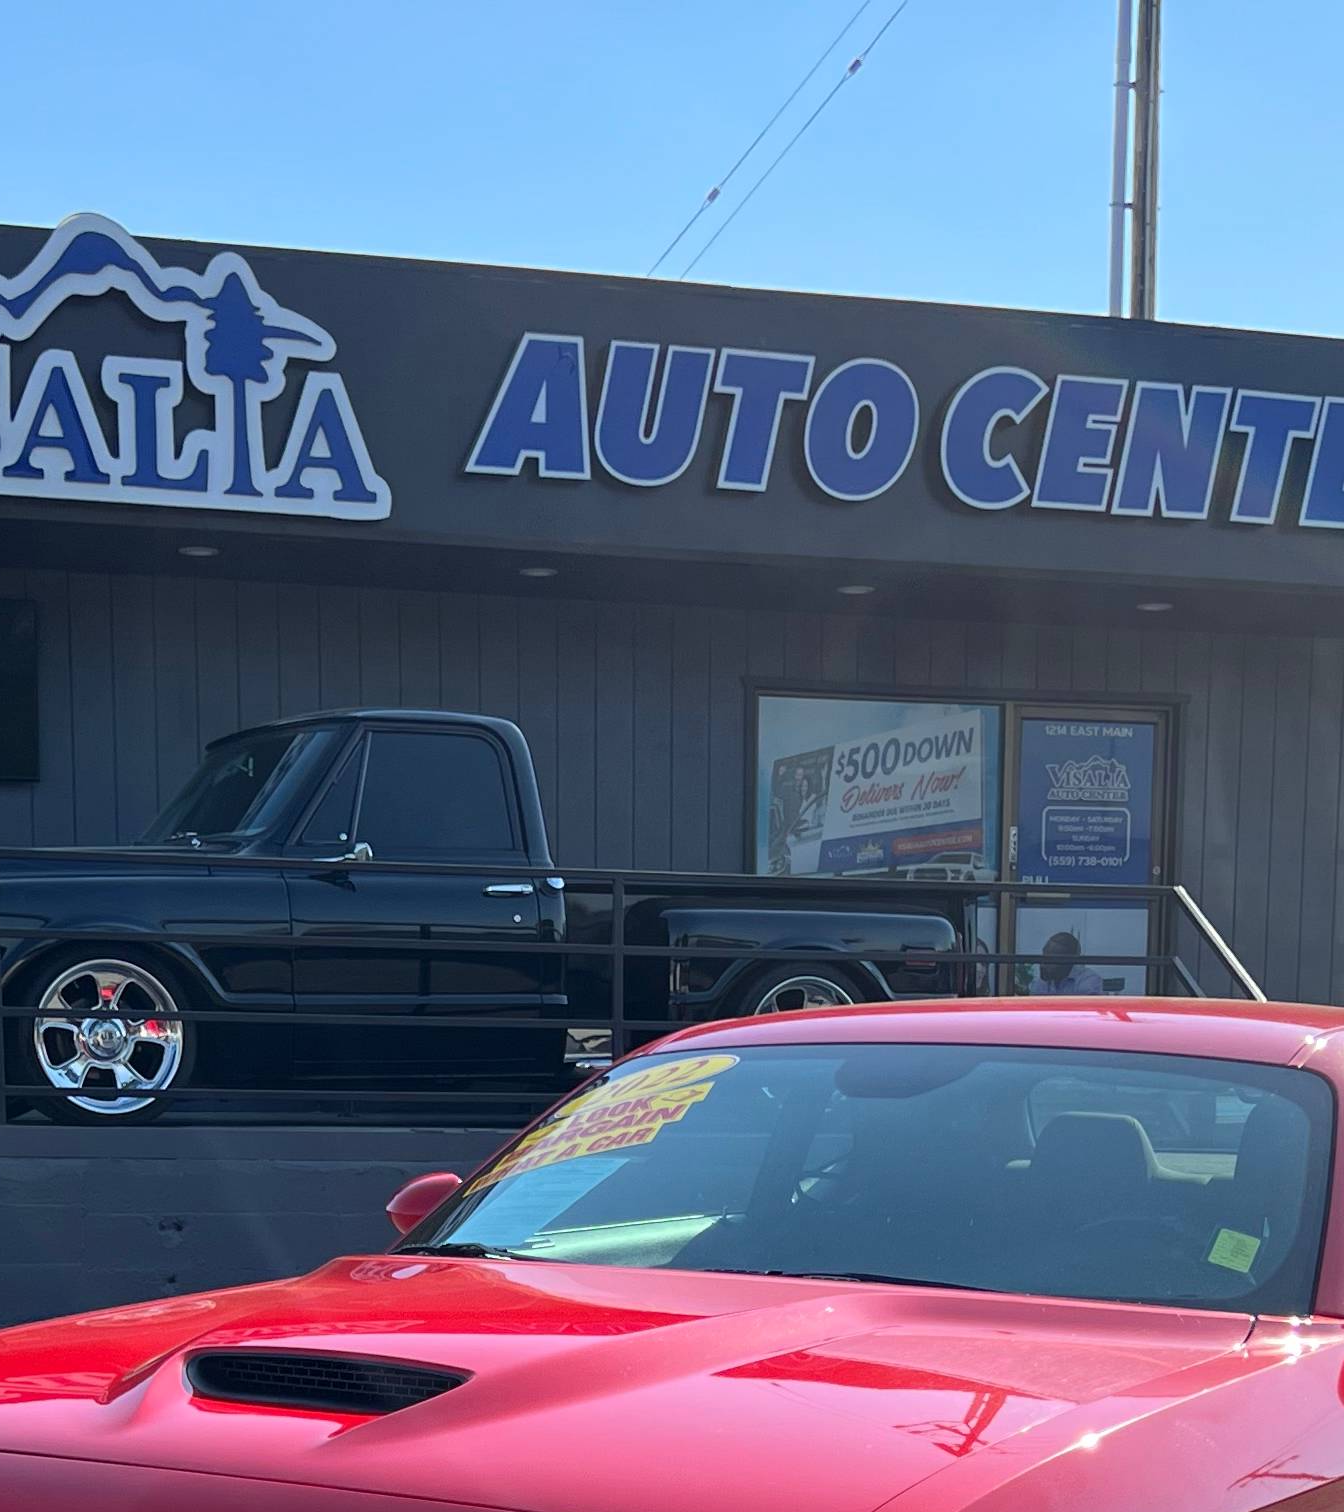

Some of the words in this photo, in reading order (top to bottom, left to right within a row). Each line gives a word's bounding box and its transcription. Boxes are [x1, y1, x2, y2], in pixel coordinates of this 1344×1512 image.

[466, 332, 919, 502] AUTO
[1070, 726, 1098, 737] EAST
[1102, 727, 1134, 738] MAIN
[835, 738, 901, 783] $500
[903, 728, 974, 767] DOWN
[1045, 754, 1131, 789] VISALIA
[840, 783, 904, 813] Delivers
[911, 766, 966, 801] Now!
[1047, 788, 1080, 800] AUTO
[1081, 789, 1129, 801] CENTER
[1049, 856, 1076, 867] (559)
[567, 1098, 653, 1130] LOOK
[559, 1143, 582, 1159] A
[586, 1127, 653, 1153] CAR
